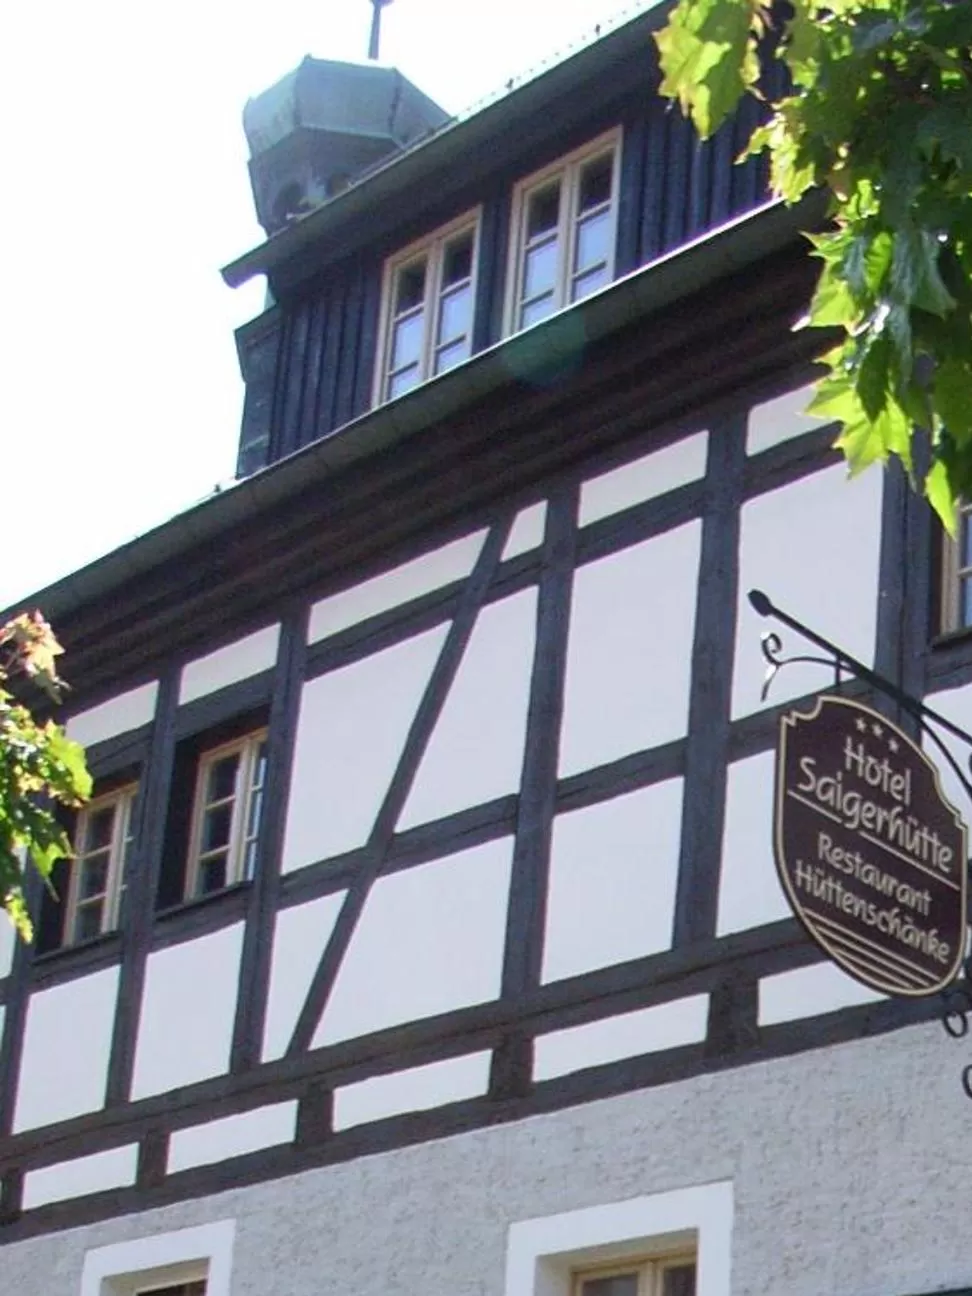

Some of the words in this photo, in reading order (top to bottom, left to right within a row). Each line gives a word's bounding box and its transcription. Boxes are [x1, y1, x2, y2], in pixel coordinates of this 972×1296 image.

[797, 756, 953, 874] Saigerhütte
[843, 735, 912, 807] Hotel
[794, 858, 951, 965] Hüttenschänke
[817, 831, 933, 916] Restaurant
